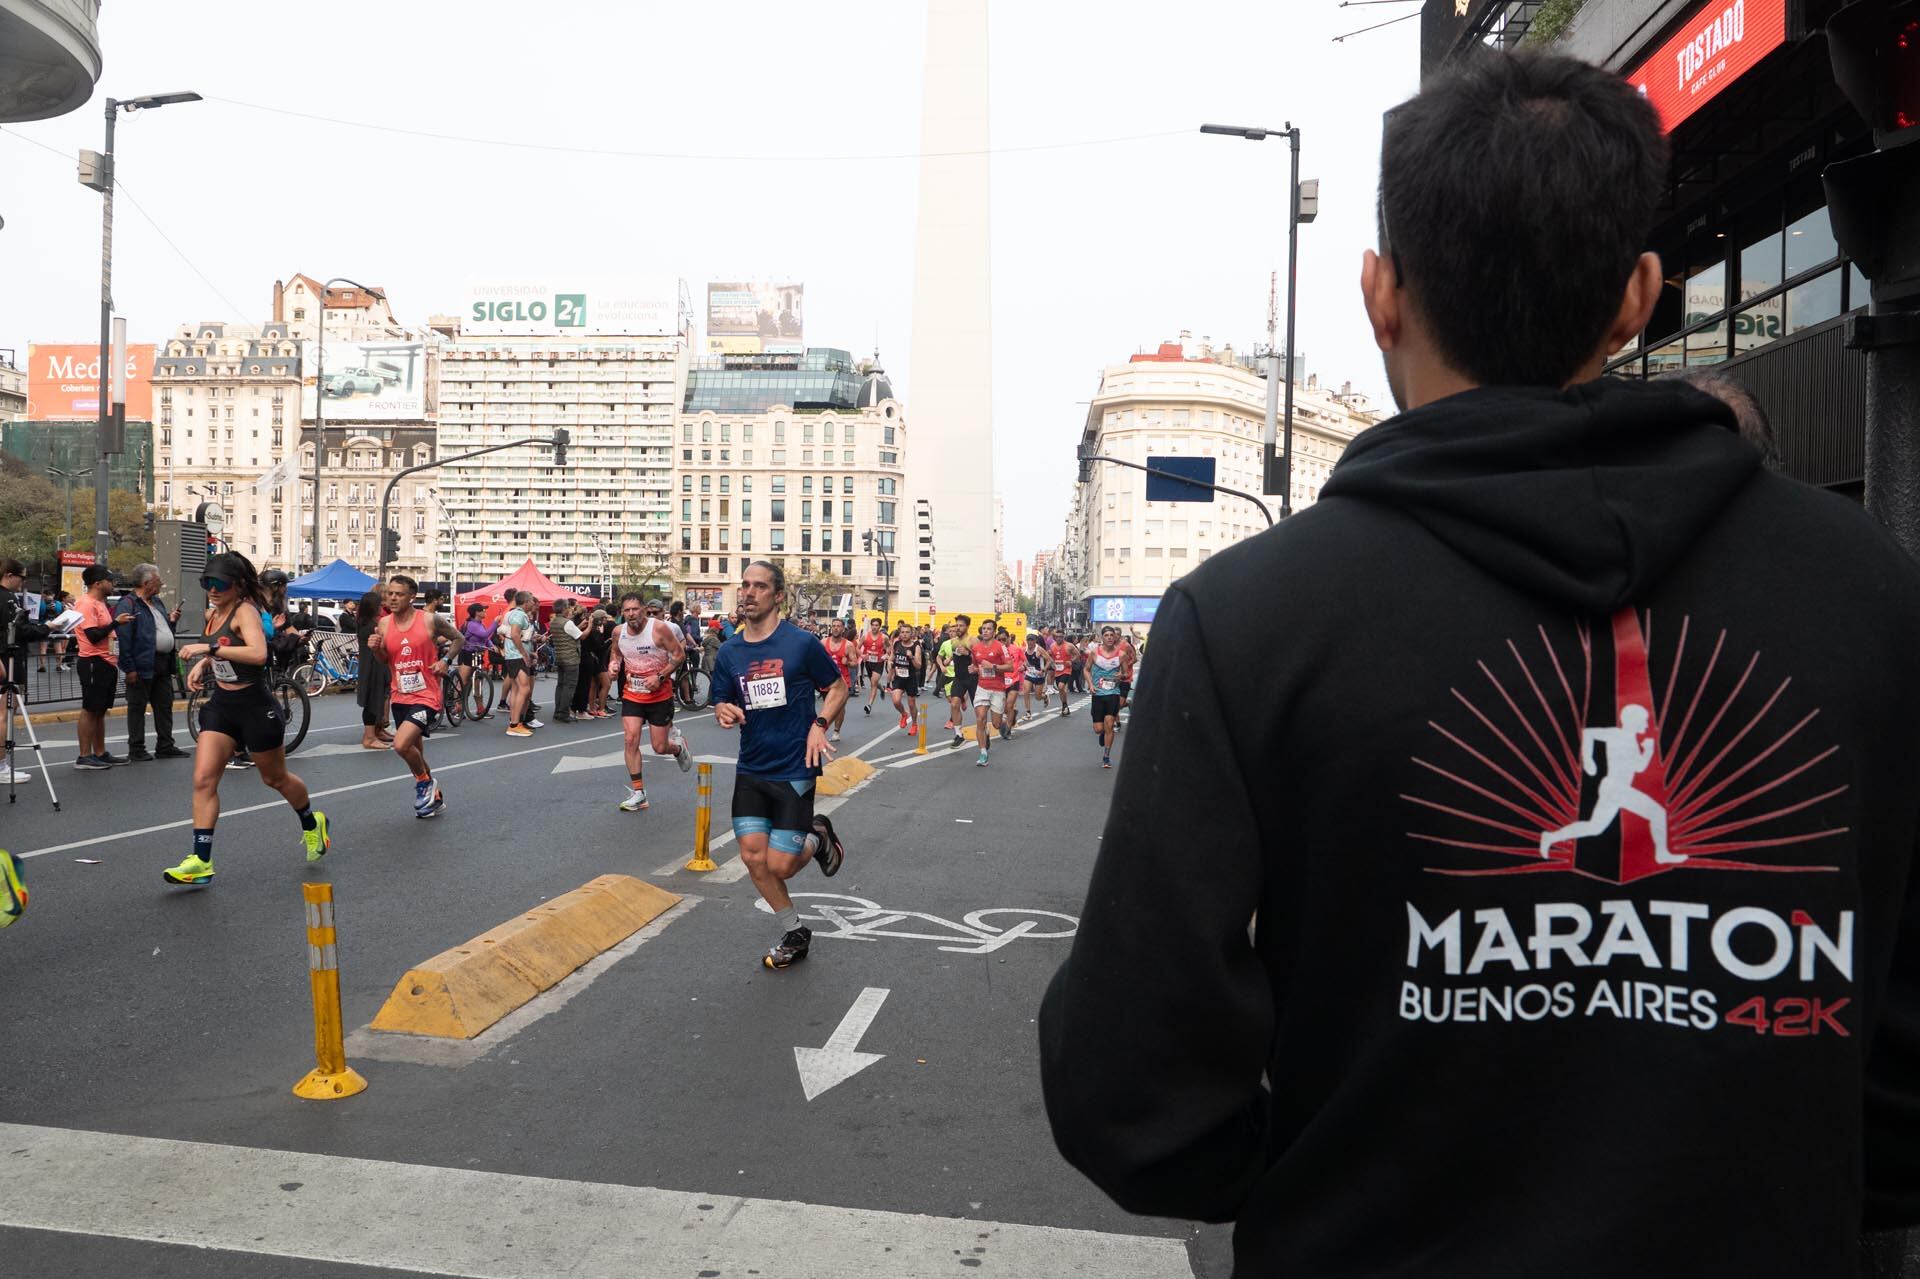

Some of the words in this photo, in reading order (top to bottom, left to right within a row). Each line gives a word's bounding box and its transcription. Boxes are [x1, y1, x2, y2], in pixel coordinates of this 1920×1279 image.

[1676, 0, 1745, 91] TOSTADO
[1690, 73, 1708, 95] CAFE
[1708, 58, 1727, 80] CLUB
[473, 286, 546, 296] UNIVERSIDAD
[472, 301, 547, 322] SIGLO
[557, 299, 583, 327] 21
[369, 401, 418, 410] FRONTIER
[752, 681, 780, 697] 11882
[1406, 899, 1855, 982] MARATON
[1399, 980, 1577, 1023] BUENOS
[1584, 979, 1718, 1030] AIRES
[1724, 995, 1852, 1037] 42K
